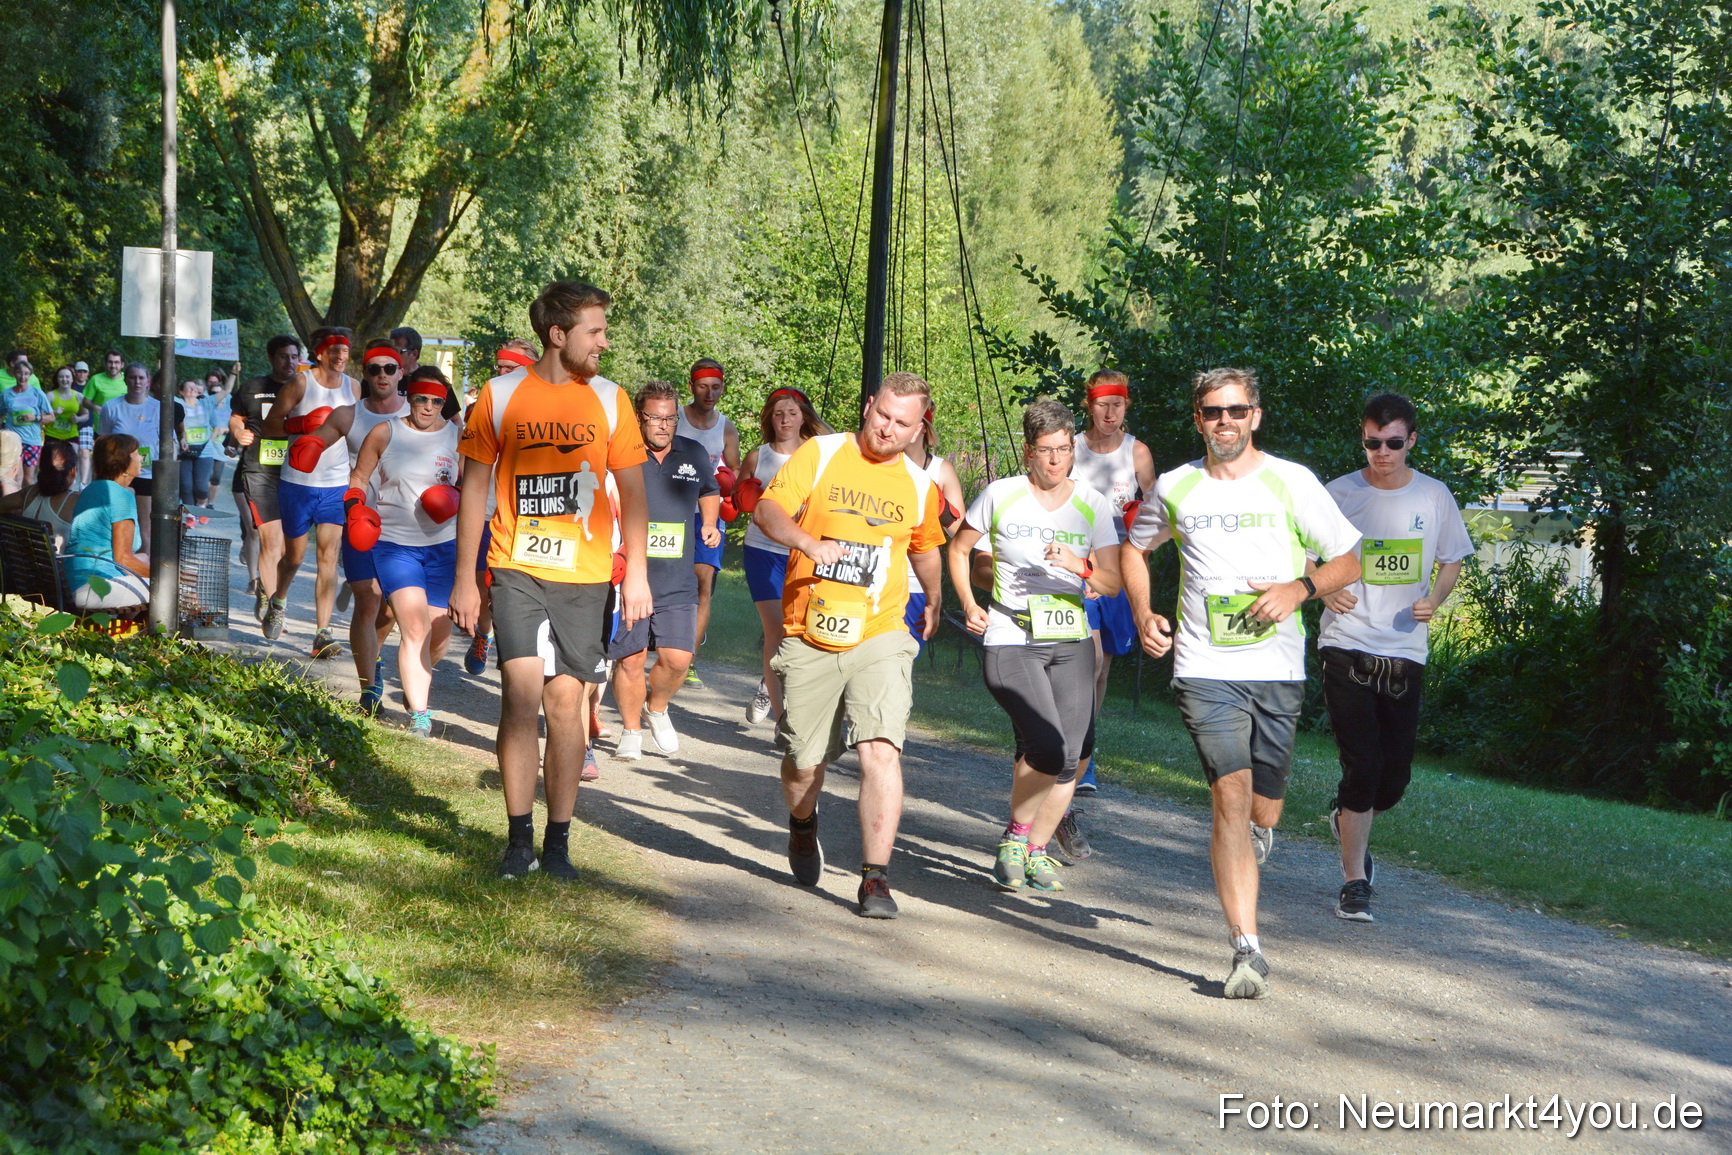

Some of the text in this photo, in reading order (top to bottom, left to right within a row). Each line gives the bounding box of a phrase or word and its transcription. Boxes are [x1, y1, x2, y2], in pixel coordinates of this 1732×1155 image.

[516, 421, 596, 443] BIT WINGS
[519, 496, 565, 515] BEI UNS
[828, 484, 905, 523] BIT WINGS
[1183, 512, 1277, 534] gangart
[649, 534, 676, 548] 284
[1006, 522, 1086, 546] gangart
[526, 535, 562, 556] 201
[836, 564, 863, 583] UNS
[1375, 555, 1410, 572] 480
[815, 613, 850, 634] 202
[1043, 609, 1075, 626] 706
